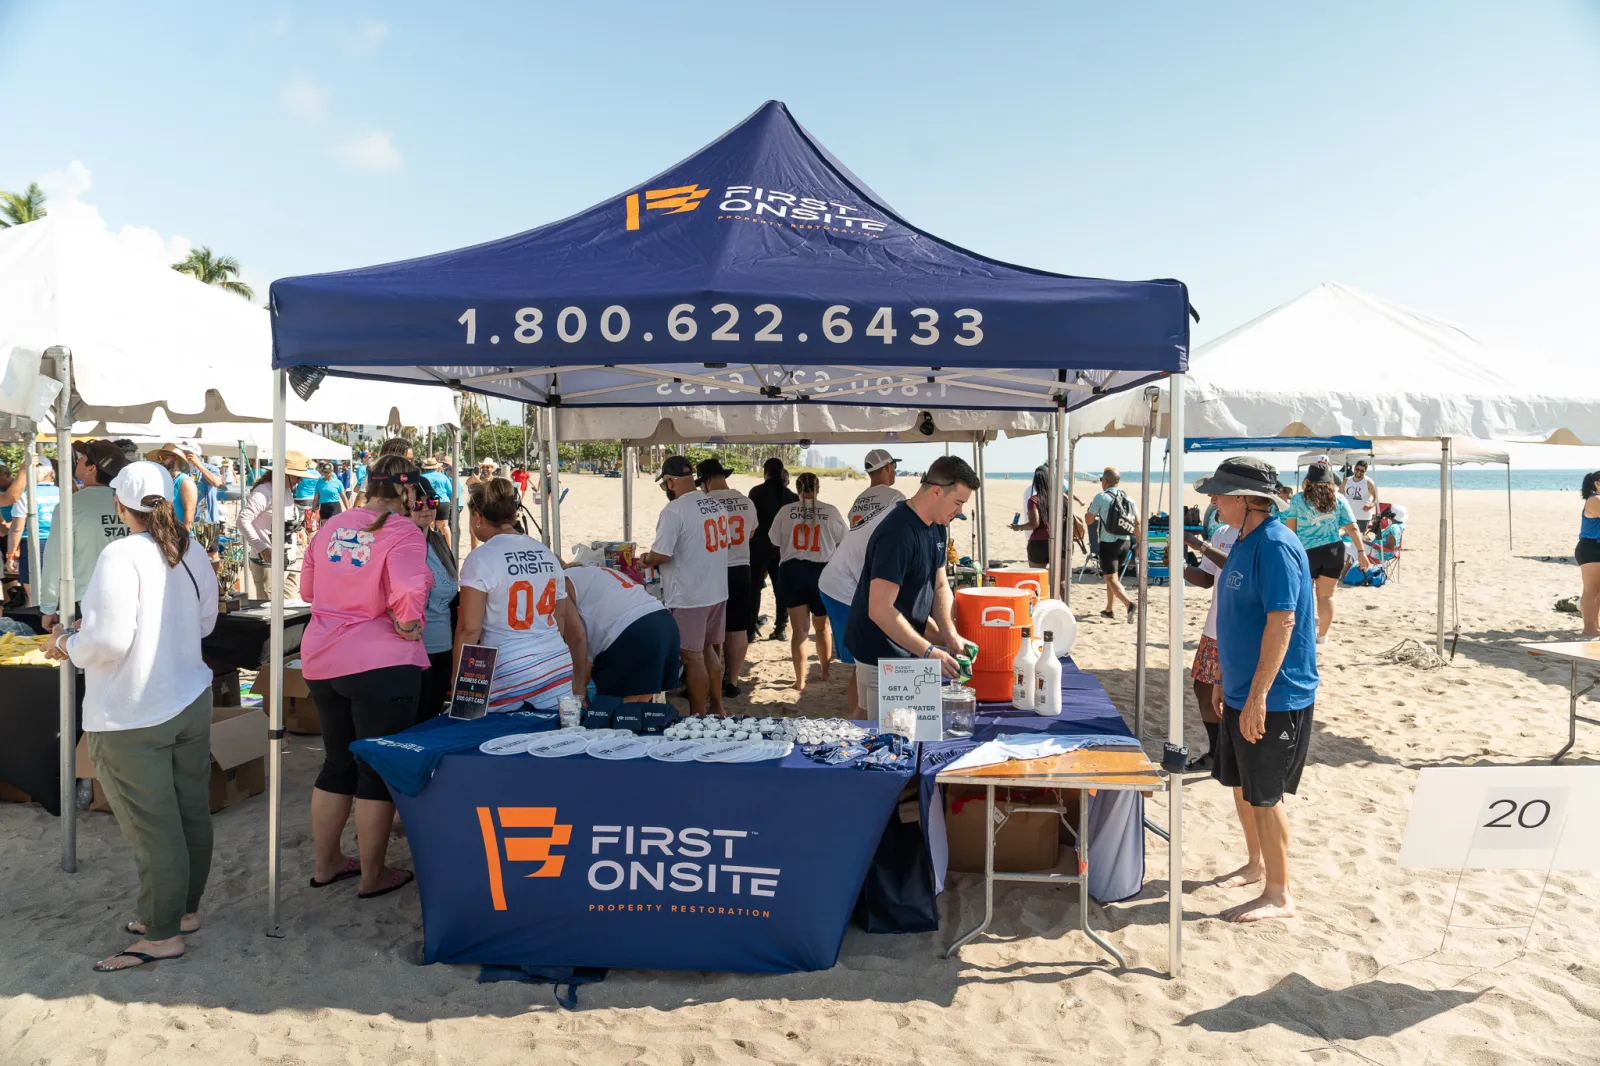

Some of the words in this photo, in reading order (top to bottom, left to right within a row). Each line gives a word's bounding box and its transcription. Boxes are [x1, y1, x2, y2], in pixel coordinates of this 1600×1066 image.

[724, 185, 858, 212] FIRST
[718, 215, 783, 228] PROPERTY
[790, 223, 880, 239] RESTORATION
[719, 199, 888, 231] ONSITE
[458, 303, 984, 346] 1.800.622.6433
[793, 523, 820, 552] 01
[504, 550, 543, 563] FIRST
[508, 562, 554, 576] ONSITE
[507, 578, 556, 630] 04
[1482, 799, 1551, 828] 20
[592, 825, 748, 859] FIRST
[588, 860, 781, 897] ONSITE
[588, 904, 663, 912] PROPERTY
[671, 905, 771, 918] RESTORATION
